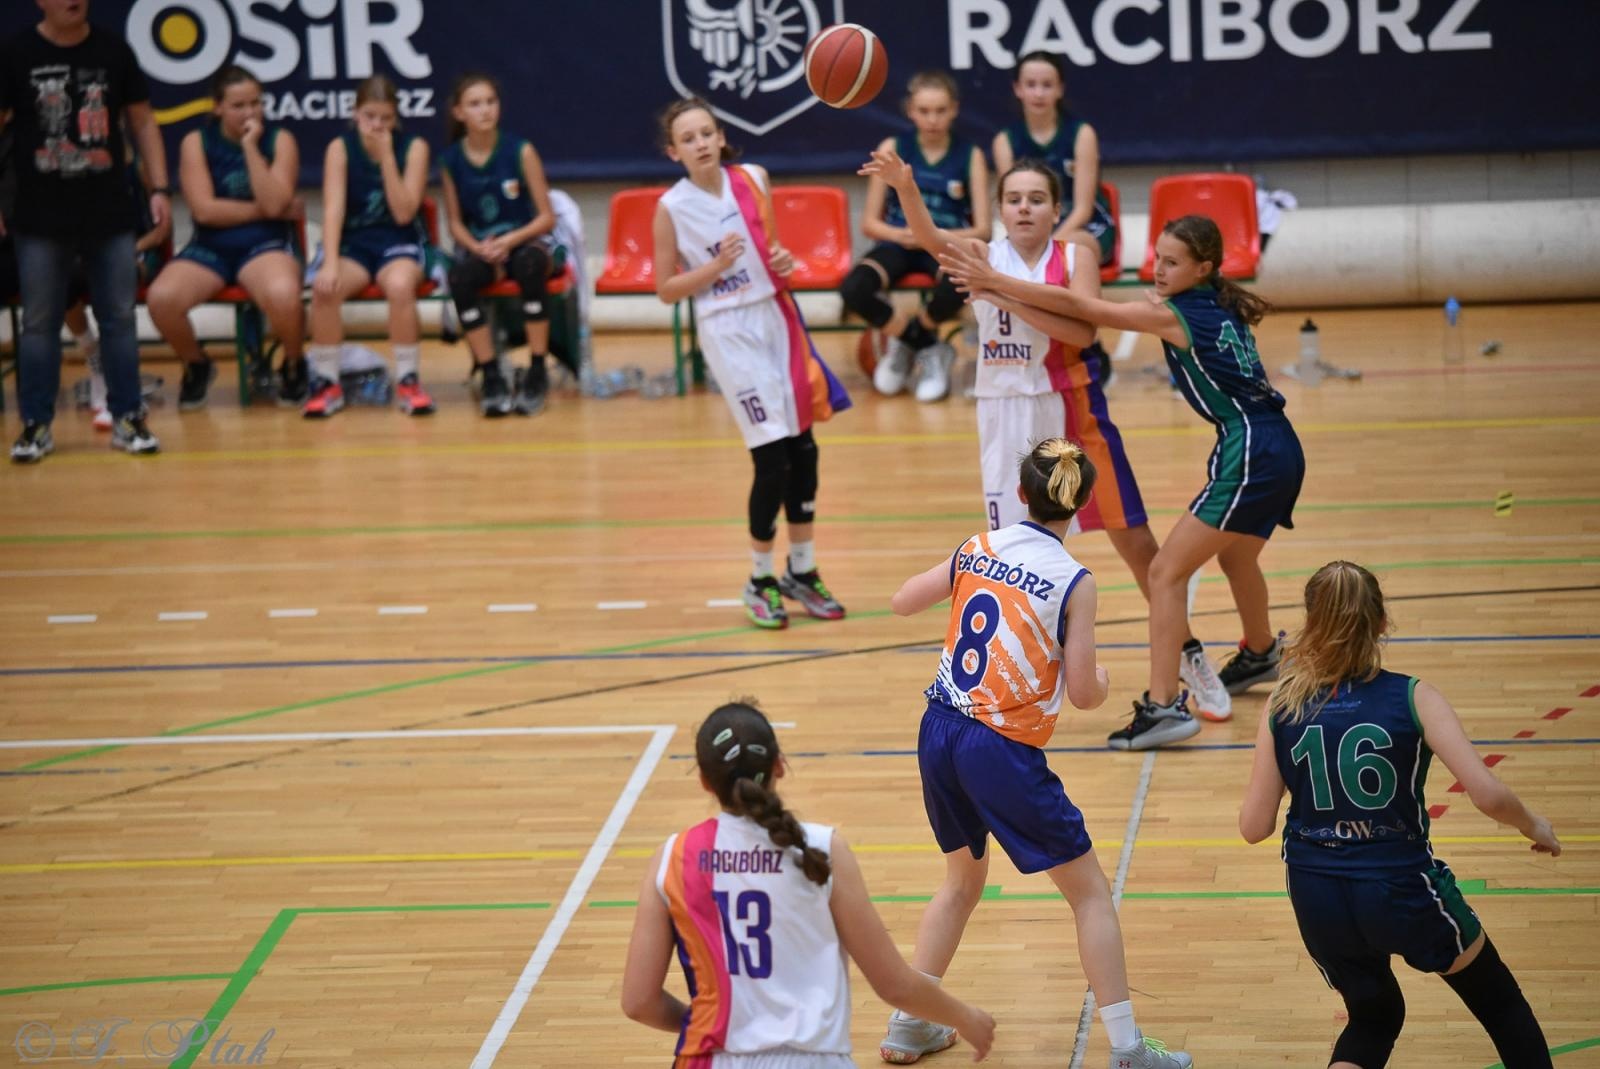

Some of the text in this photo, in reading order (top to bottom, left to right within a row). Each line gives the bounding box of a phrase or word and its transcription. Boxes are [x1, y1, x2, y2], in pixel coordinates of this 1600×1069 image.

[126, 0, 433, 84] OSiR
[261, 88, 435, 120] RACIBRZ
[983, 343, 1032, 361] MINI
[740, 396, 767, 426] 16
[989, 501, 1000, 531] 9
[950, 592, 1001, 693] 8
[1291, 723, 1397, 810] 16
[1335, 819, 1374, 840] GW
[699, 844, 784, 874] RACIBÓRZ
[711, 890, 773, 979] 13
